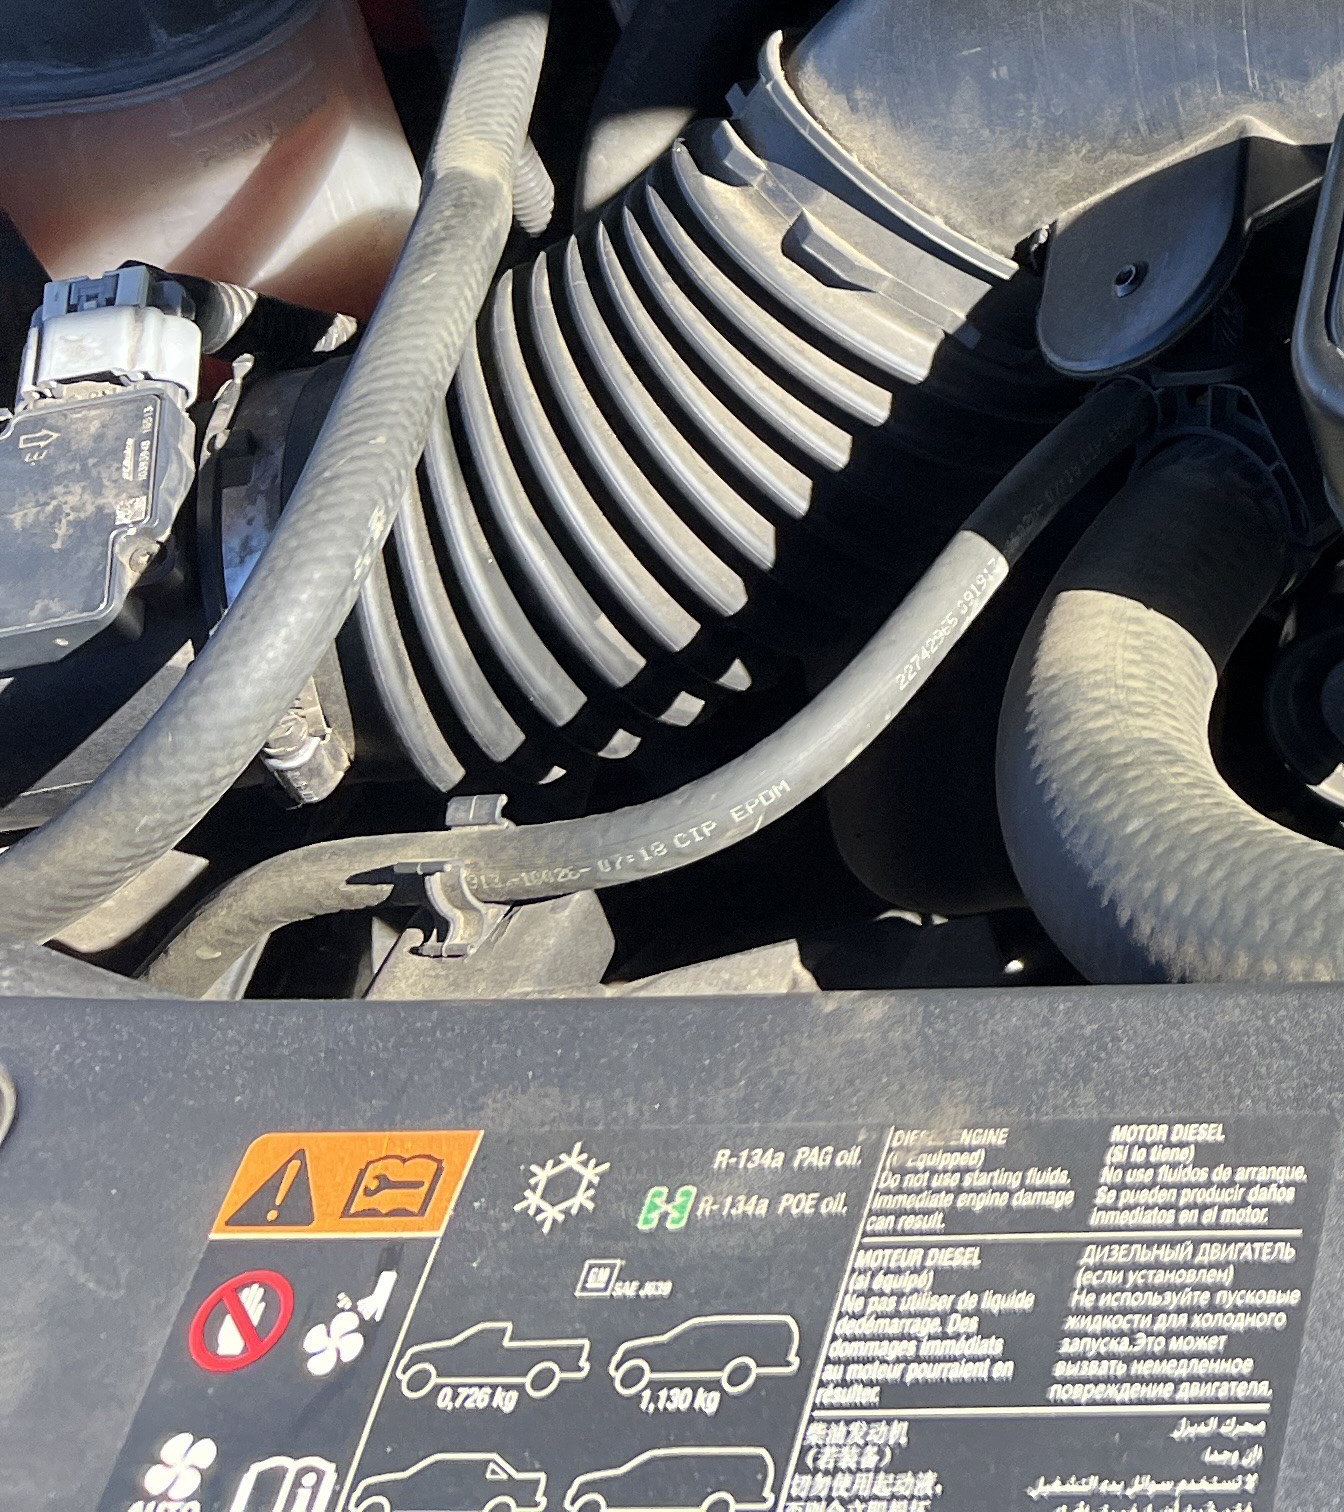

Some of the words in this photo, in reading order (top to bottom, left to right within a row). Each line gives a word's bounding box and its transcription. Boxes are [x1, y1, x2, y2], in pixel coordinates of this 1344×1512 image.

[673, 819, 718, 849] CIP
[730, 779, 792, 823] EPDM
[1109, 1123, 1170, 1143] MOTOR
[1170, 1123, 1226, 1143] DIESEL
[712, 1147, 786, 1170] R-134a
[793, 1145, 835, 1171] PAG
[834, 1144, 862, 1168] oil.
[1149, 1143, 1196, 1166] tiene)
[879, 1170, 901, 1190] Do
[902, 1170, 930, 1190] not
[930, 1172, 960, 1190] use
[962, 1168, 1023, 1192] starting
[1024, 1166, 1072, 1188] fluids.
[1100, 1165, 1123, 1185] No
[1125, 1167, 1155, 1184] use
[1157, 1164, 1210, 1183] fluidos
[1211, 1163, 1231, 1183] de
[1234, 1165, 1308, 1185] arranque.
[696, 1193, 770, 1219] R-134a
[777, 1191, 821, 1217] POE
[820, 1190, 848, 1216] oil.
[872, 1190, 955, 1212] Immediate
[956, 1191, 1010, 1213] engine
[1011, 1189, 1076, 1213] damage
[1094, 1185, 1117, 1206] Se
[1118, 1186, 1178, 1208] pueden
[1178, 1184, 1247, 1207] producir
[1247, 1183, 1296, 1204] daños
[866, 1214, 896, 1233] can
[897, 1211, 946, 1232] result.
[1178, 1208, 1200, 1227] en
[1201, 1205, 1219, 1225] el
[1219, 1205, 1269, 1226] motor.
[852, 1248, 925, 1271] MOTEUR
[924, 1246, 982, 1270] DIESEL
[1079, 1241, 1194, 1266] ДИЗЕЛЬНЫЙ
[1195, 1241, 1297, 1266] ДВИГАТЕЛЬ
[872, 1268, 935, 1294] équipé)
[1076, 1266, 1125, 1288] (если
[1126, 1265, 1235, 1288] установлен)
[841, 1293, 866, 1314] Ne
[866, 1295, 898, 1317] pas
[899, 1291, 956, 1315] utiliser
[956, 1290, 979, 1314] de
[980, 1288, 1036, 1317] liquide
[1071, 1288, 1096, 1309] Не
[1097, 1287, 1210, 1310] используйте
[1215, 1288, 1302, 1309] пусковые
[946, 1312, 980, 1337] Des
[1063, 1312, 1153, 1333] жидкости
[1154, 1312, 1189, 1333] для
[1190, 1311, 1287, 1333] холодного
[828, 1338, 918, 1362] dommages
[918, 1335, 1005, 1360] immédiats
[1167, 1334, 1229, 1355] может
[821, 1363, 845, 1384] au
[845, 1359, 906, 1383] moteur
[905, 1358, 991, 1386] pourraient
[991, 1360, 1015, 1383] en
[1052, 1359, 1128, 1380] вызвать
[1129, 1357, 1255, 1380] немедленное
[436, 1385, 493, 1413] 0,726
[492, 1384, 520, 1414] kg
[640, 1387, 693, 1416] 1,130
[693, 1386, 721, 1418] kg
[1047, 1381, 1175, 1406] повреждение
[1176, 1380, 1273, 1405] двигателя.
